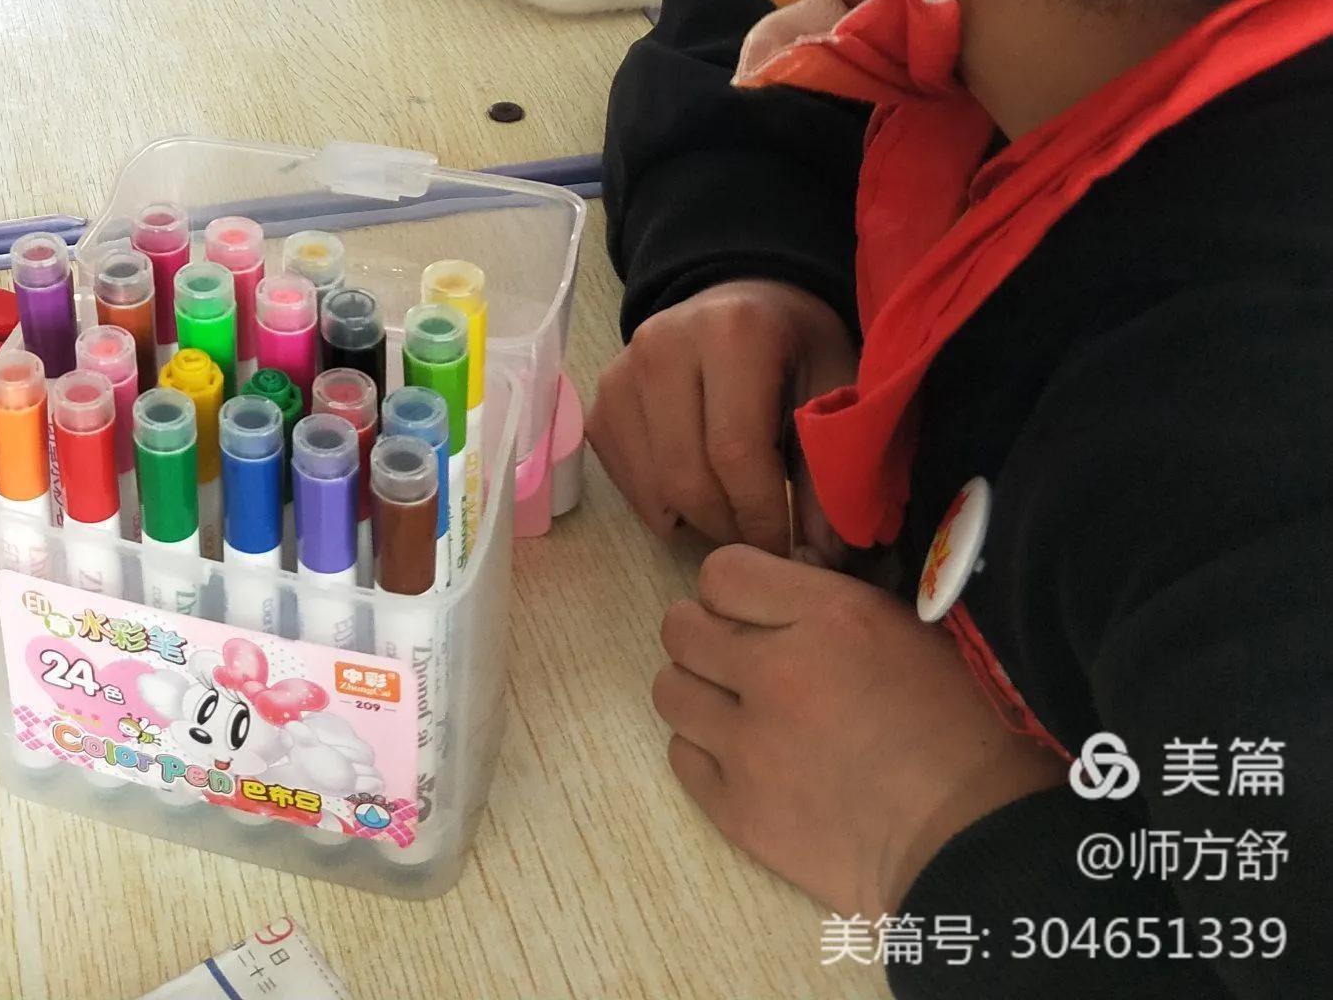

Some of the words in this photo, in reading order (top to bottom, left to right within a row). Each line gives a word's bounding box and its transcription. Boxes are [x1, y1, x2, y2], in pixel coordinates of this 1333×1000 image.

[73, 608, 188, 665] 水彩笔
[341, 667, 388, 688] 中彩
[355, 700, 381, 712] 209
[241, 779, 323, 813] 巴布豆
